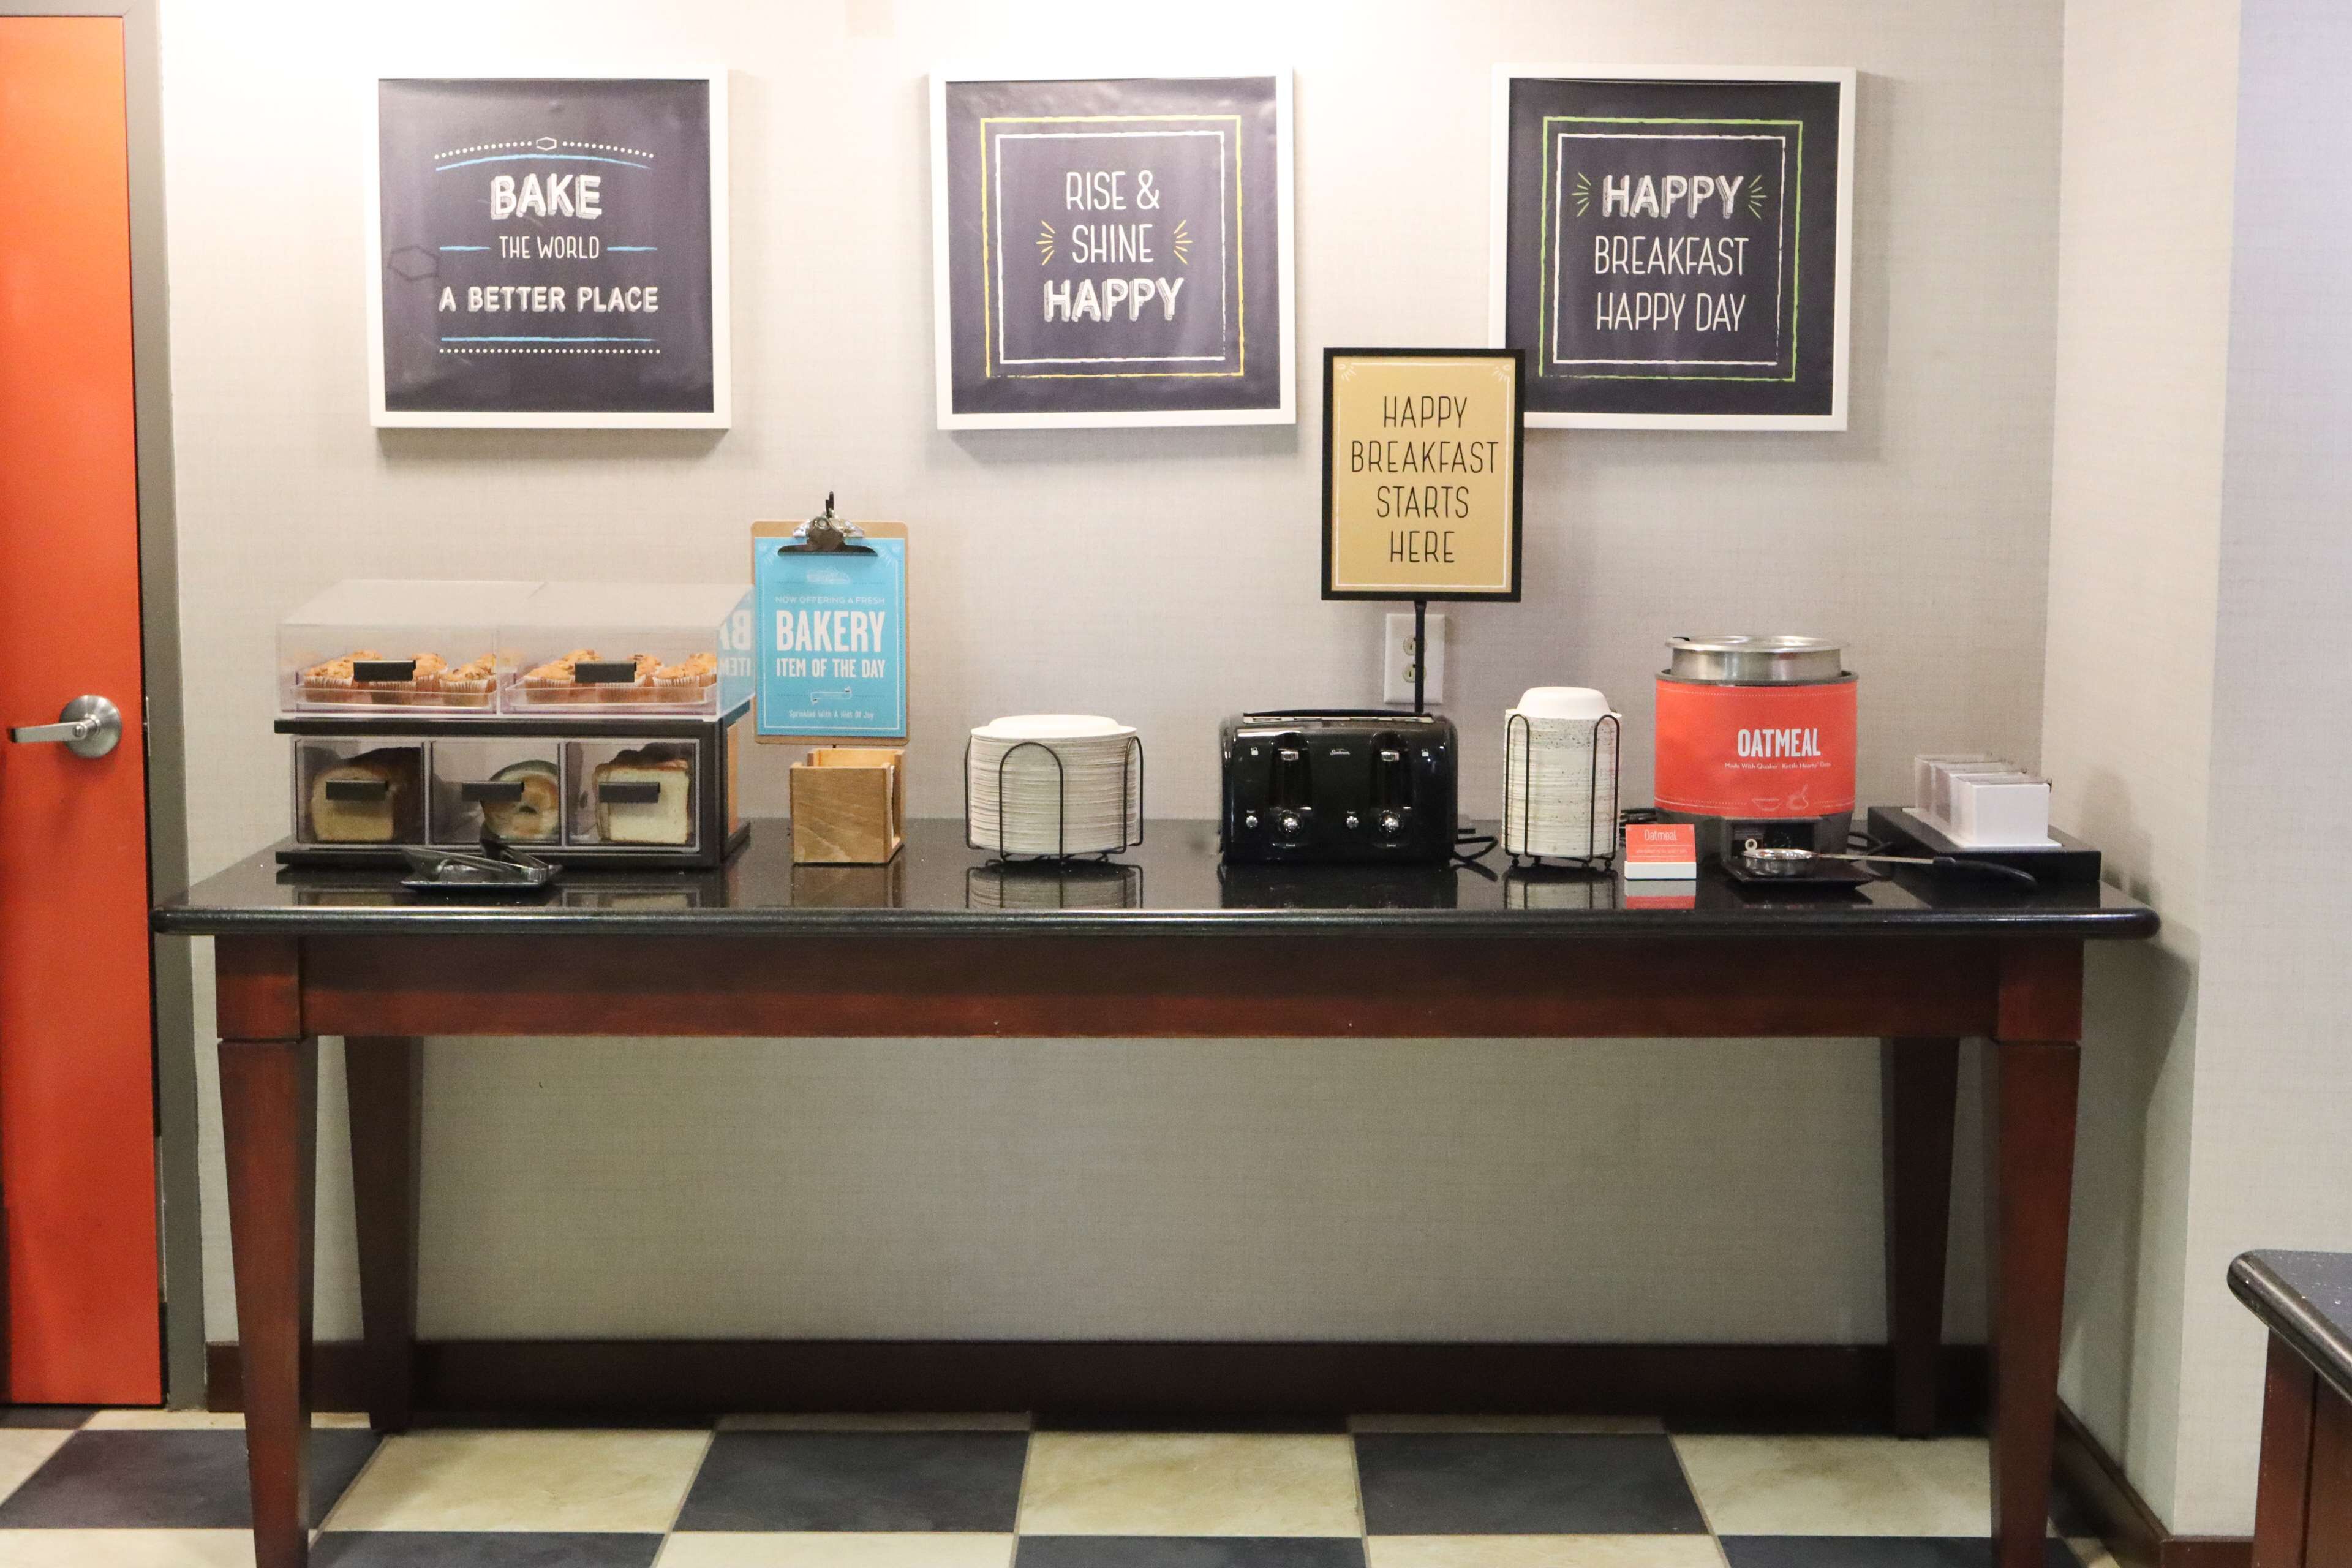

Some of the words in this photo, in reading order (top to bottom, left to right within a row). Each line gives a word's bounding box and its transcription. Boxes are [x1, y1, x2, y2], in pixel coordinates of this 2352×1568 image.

[491, 173, 602, 220] BAKE
[1066, 171, 1127, 210] RISE
[1136, 170, 1160, 210] &
[1602, 175, 1744, 219] HAPPY
[500, 236, 530, 258] THE
[537, 236, 600, 259] WORLD
[1072, 224, 1154, 263] SHINE
[1594, 236, 1749, 276] BREAKFAST
[439, 287, 456, 312] A
[468, 287, 566, 312] BETTER
[577, 287, 658, 312] PLACE
[1044, 277, 1184, 322] HAPPY
[1597, 292, 1686, 331] HAPPY
[1695, 293, 1746, 331] DAY
[1384, 396, 1468, 428] HAPPY
[1352, 441, 1499, 473] BREAKFAST
[1377, 486, 1469, 518] STARTS
[1390, 530, 1455, 563] HERE
[776, 610, 886, 652] BAKERY
[776, 658, 806, 677] ITEM
[812, 658, 827, 677] OF
[833, 658, 856, 678] THE
[862, 659, 886, 679] DAY
[1738, 728, 1821, 757] OATMEAL
[1644, 829, 1677, 840] Oatmeal
